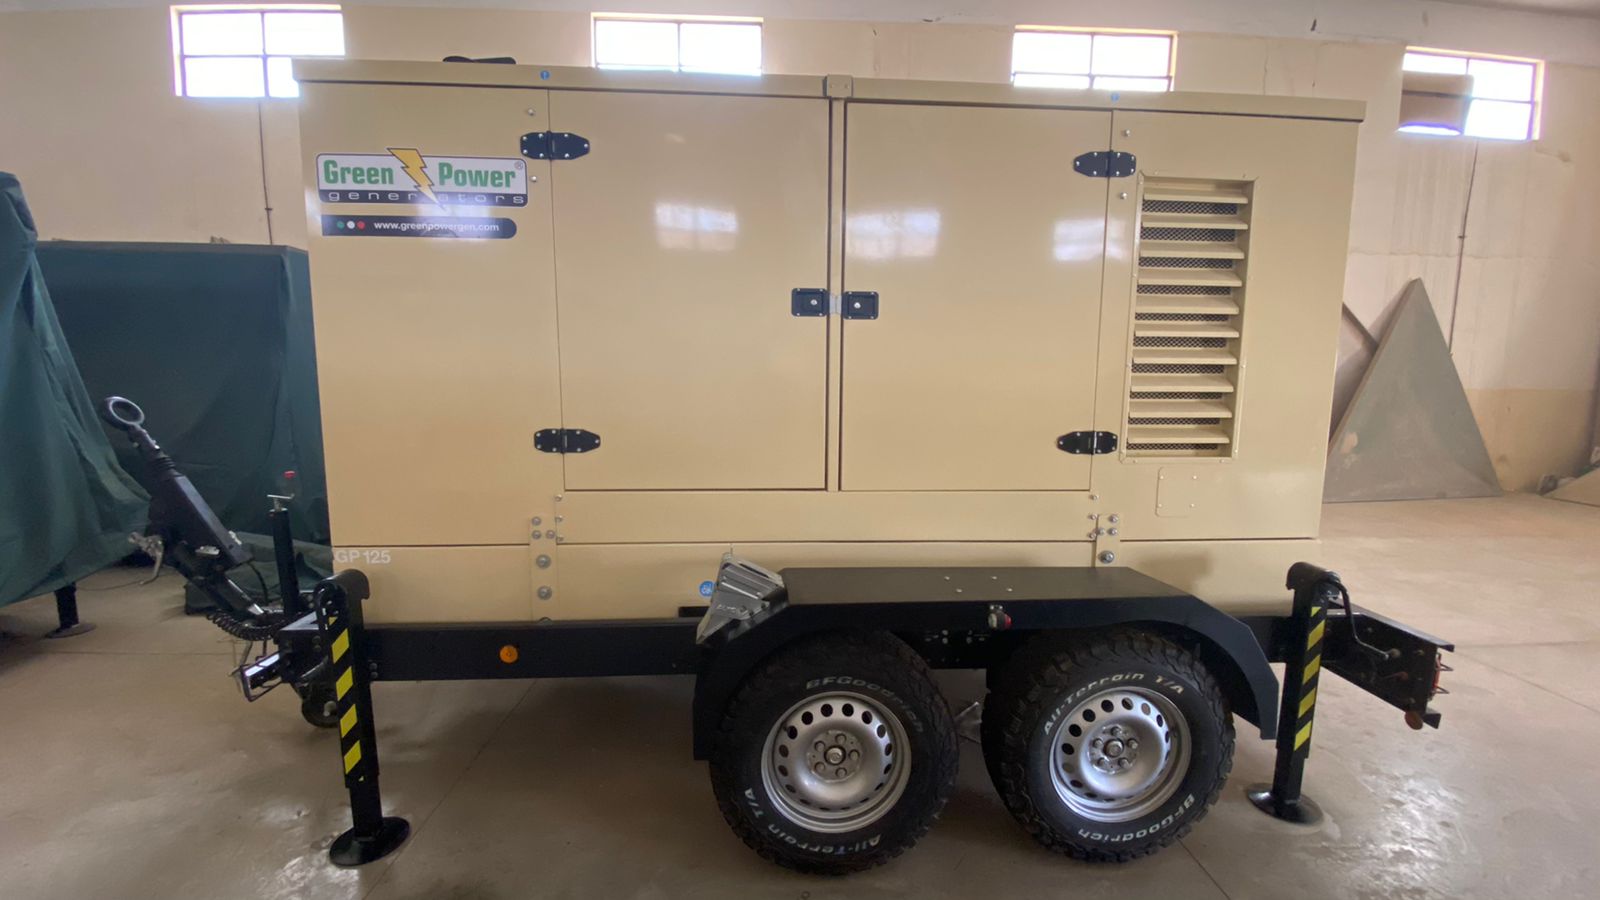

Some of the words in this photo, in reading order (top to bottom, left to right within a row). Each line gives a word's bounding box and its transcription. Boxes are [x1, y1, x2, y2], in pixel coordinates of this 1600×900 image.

[323, 159, 394, 185] Green
[328, 191, 524, 204] generators
[373, 221, 500, 233] www.greenpowergen.com
[335, 549, 360, 563] GP
[363, 550, 391, 564] 125
[1043, 671, 1145, 736] All-Terrain
[1154, 675, 1186, 695] T/A
[1078, 793, 1195, 843] BFGoodrich
